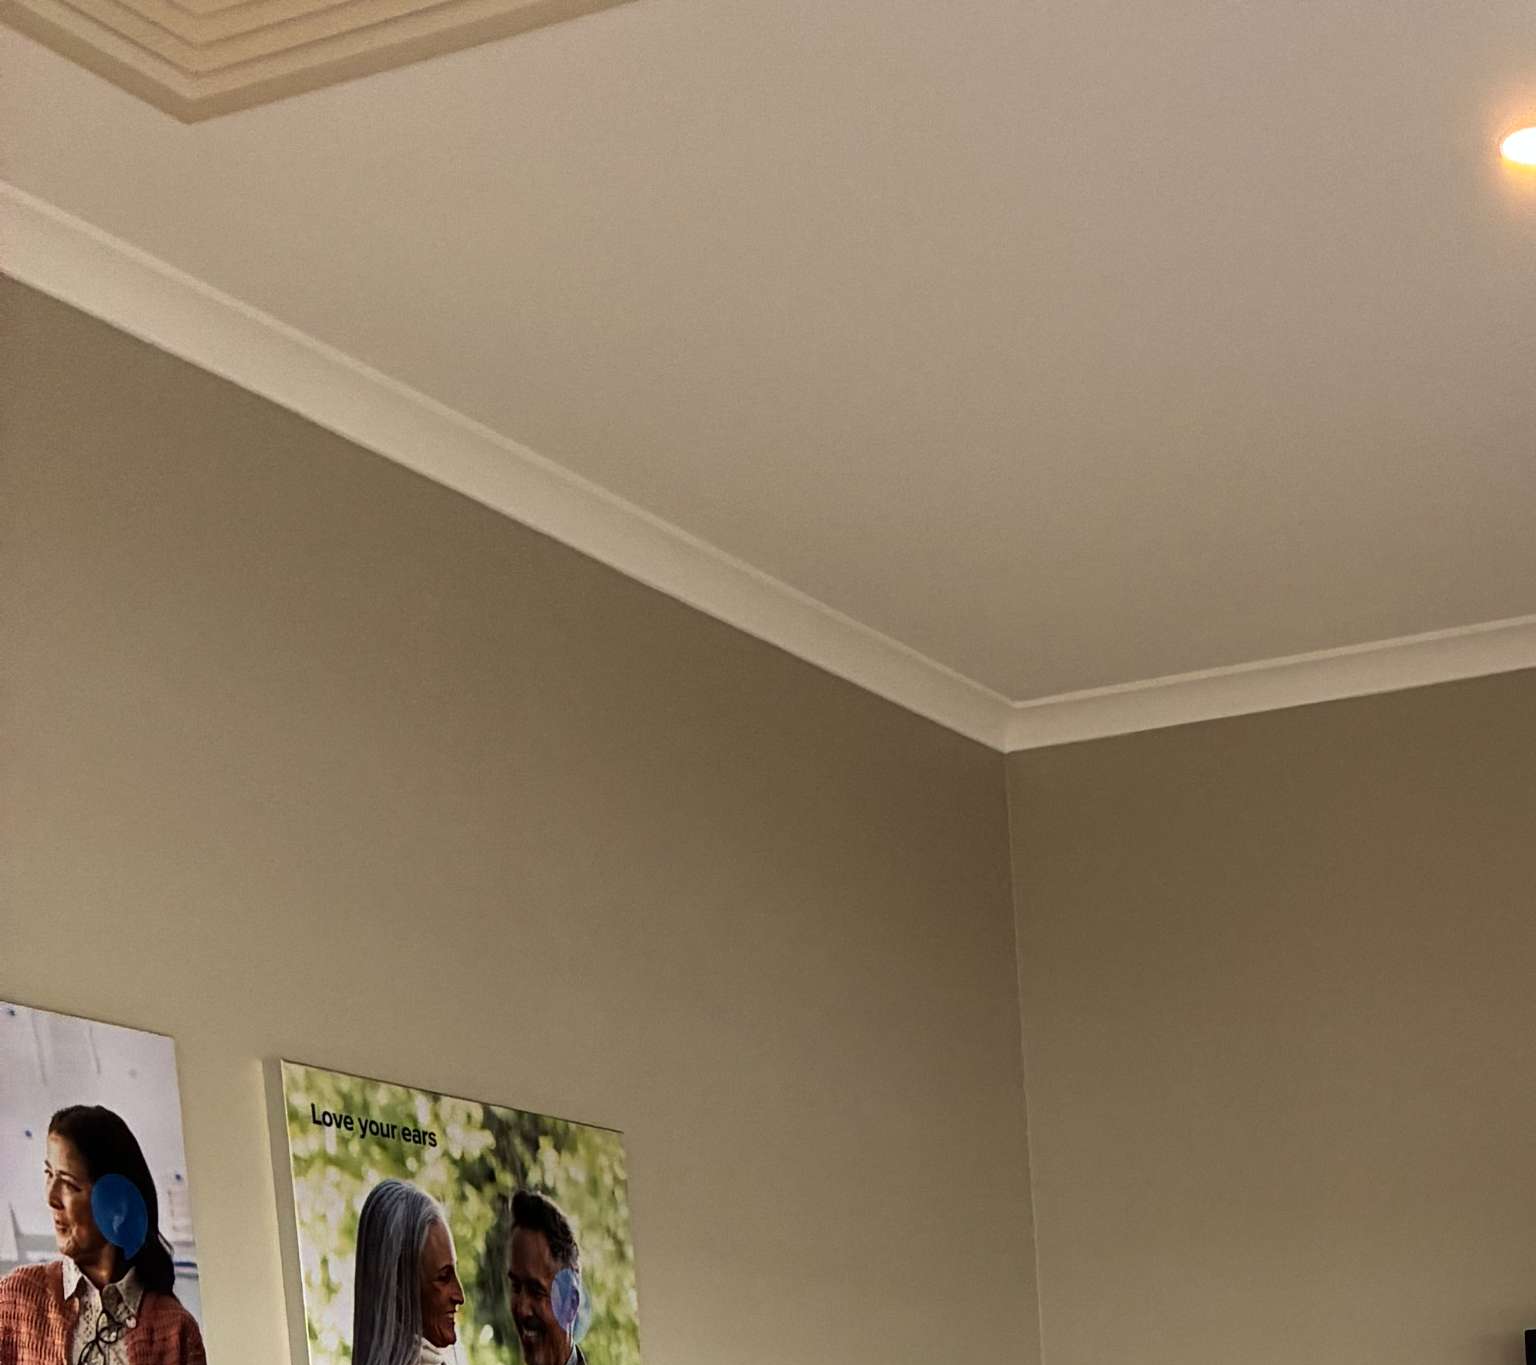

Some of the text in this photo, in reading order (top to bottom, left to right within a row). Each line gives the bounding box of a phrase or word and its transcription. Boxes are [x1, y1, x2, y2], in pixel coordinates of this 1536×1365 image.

[311, 1103, 438, 1147] Love your ears
